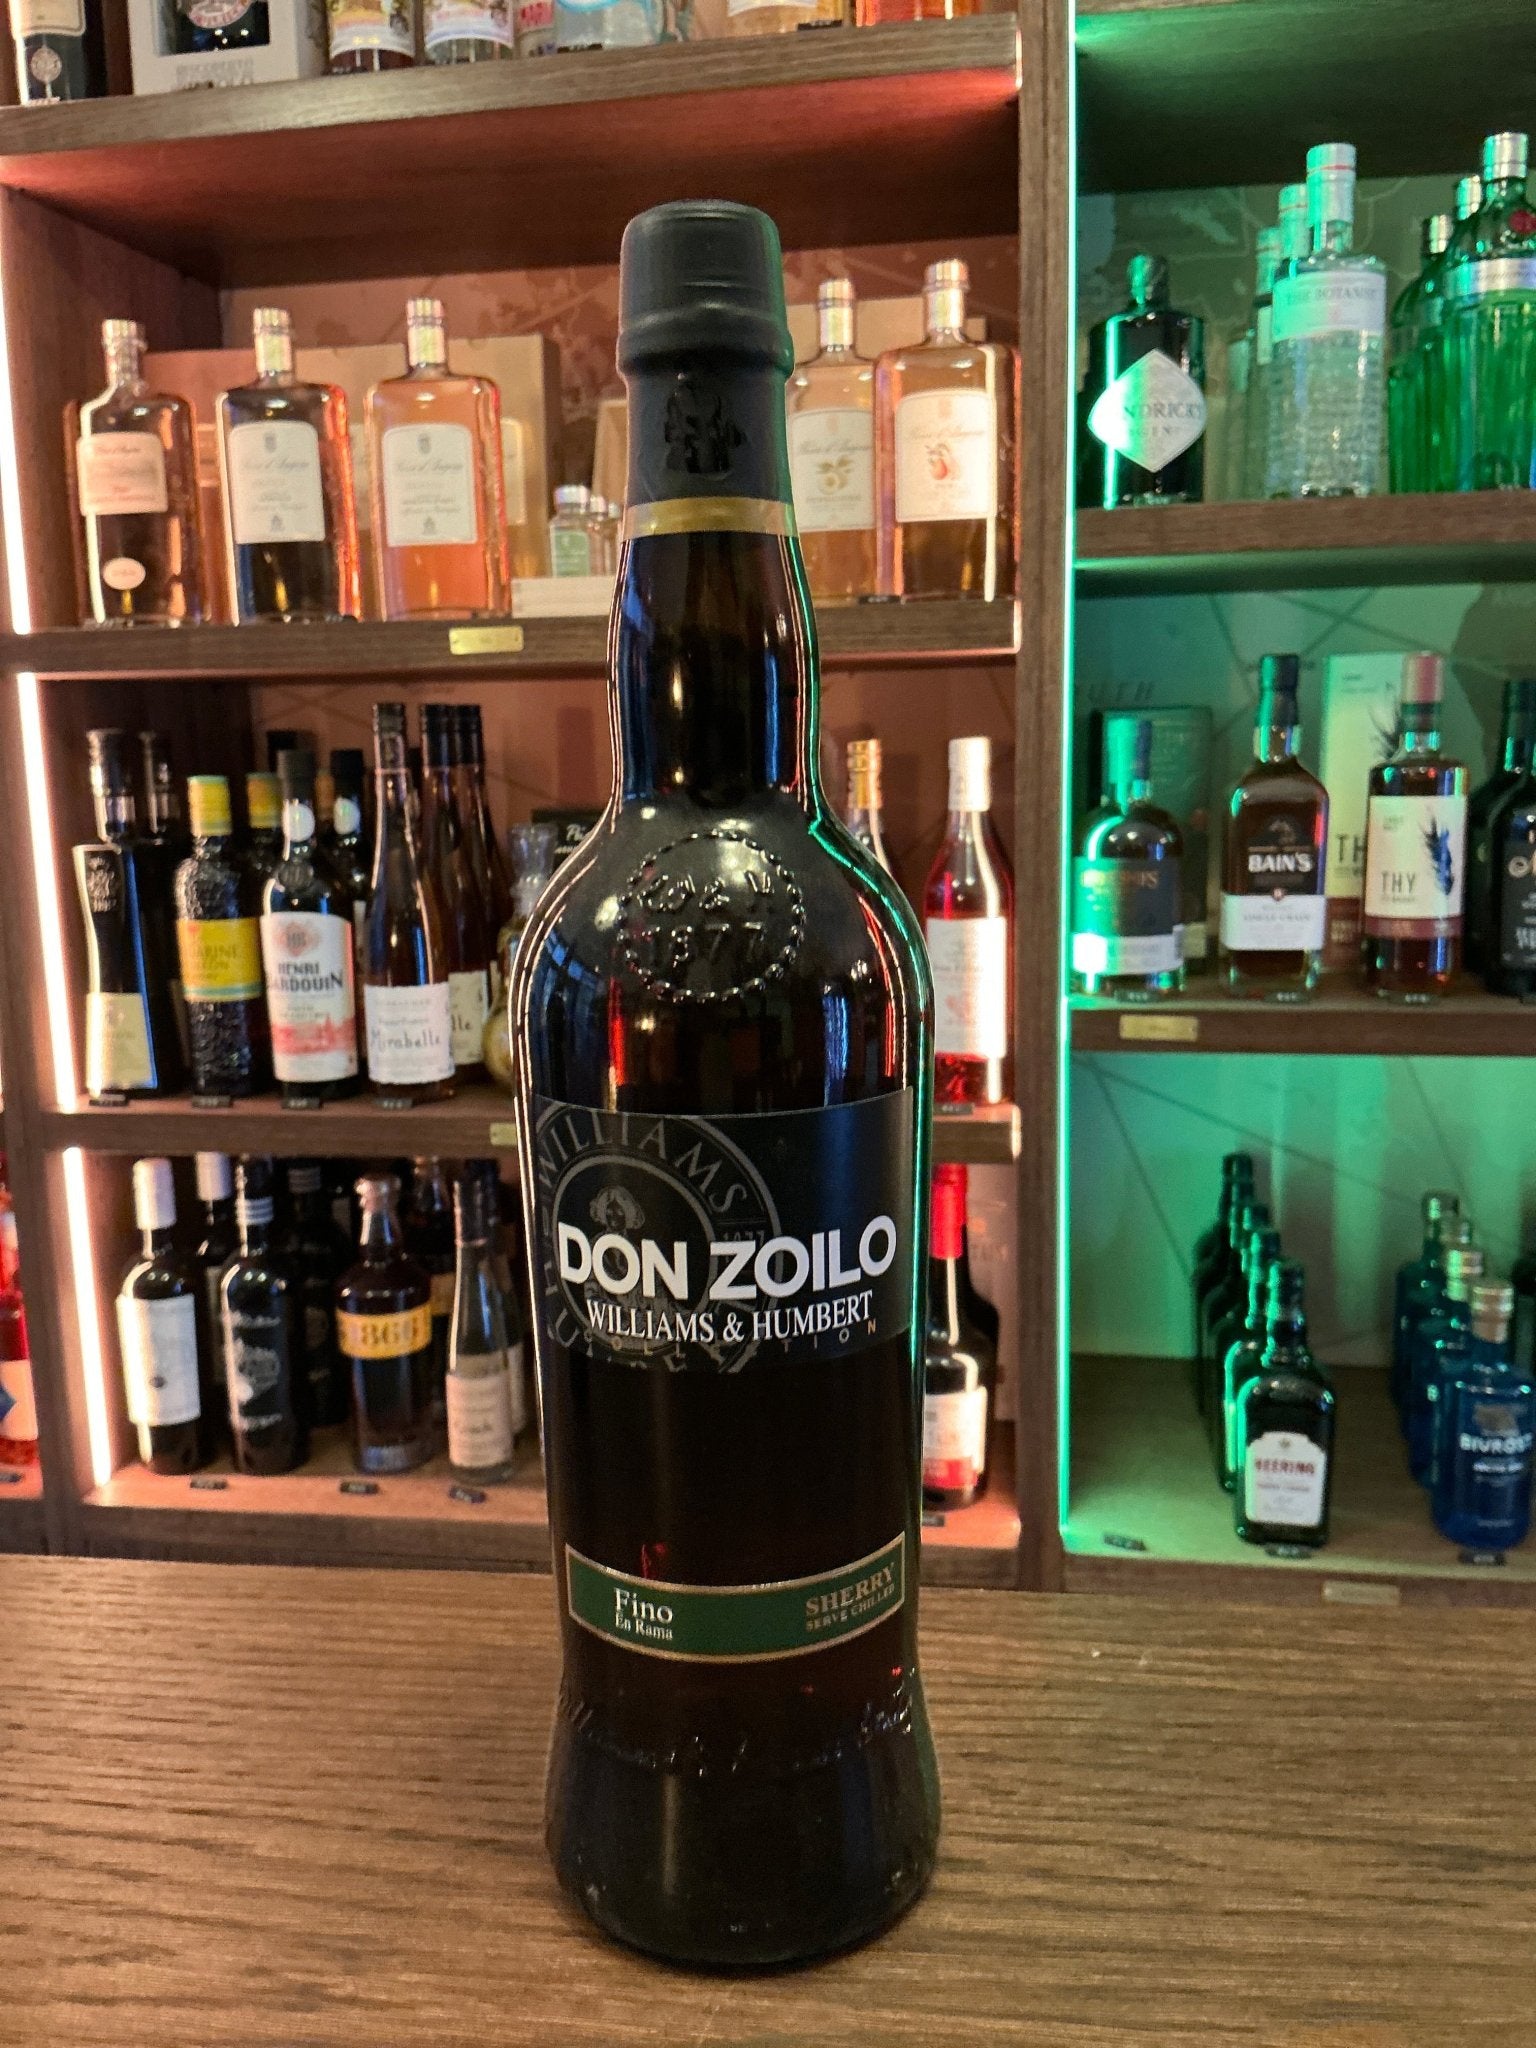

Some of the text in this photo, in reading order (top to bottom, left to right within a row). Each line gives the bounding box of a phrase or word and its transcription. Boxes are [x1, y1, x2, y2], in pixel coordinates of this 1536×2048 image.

[1248, 851, 1314, 873] BAIN'S
[1336, 834, 1364, 864] TH
[1381, 871, 1416, 895] THY
[269, 970, 343, 992] ARDOUIN
[278, 961, 320, 975] HENRI
[370, 1025, 440, 1053] Mirabelle
[538, 1110, 748, 1213] WILLIAMS
[558, 1214, 897, 1300] DON ZOILO
[586, 1288, 873, 1343] WILLIAMS & HUMBERT
[805, 1561, 896, 1617] SHERRY
[613, 1586, 674, 1625] Fino
[806, 1606, 849, 1633] SERVE
[614, 1612, 674, 1641] En Rama
